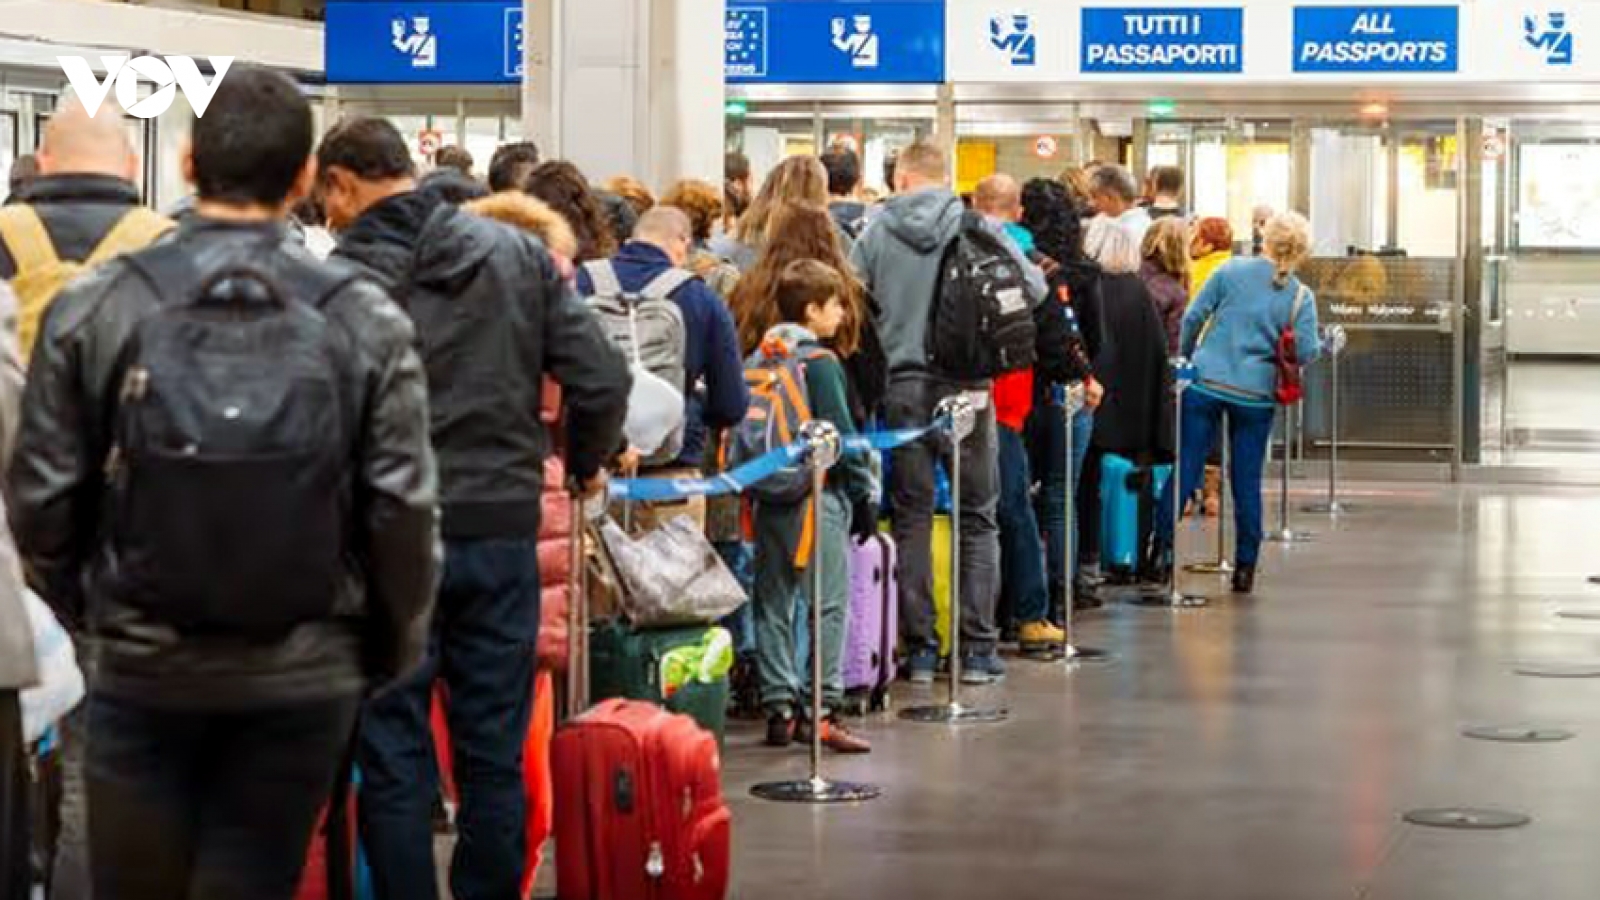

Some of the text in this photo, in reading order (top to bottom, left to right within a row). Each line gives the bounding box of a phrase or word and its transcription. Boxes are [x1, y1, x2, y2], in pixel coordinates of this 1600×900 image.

[1123, 14, 1201, 35] TUTTI I
[1351, 12, 1396, 34] ALL
[1087, 43, 1237, 65] PASSAPORTI
[1300, 41, 1448, 63] PASSPORTS
